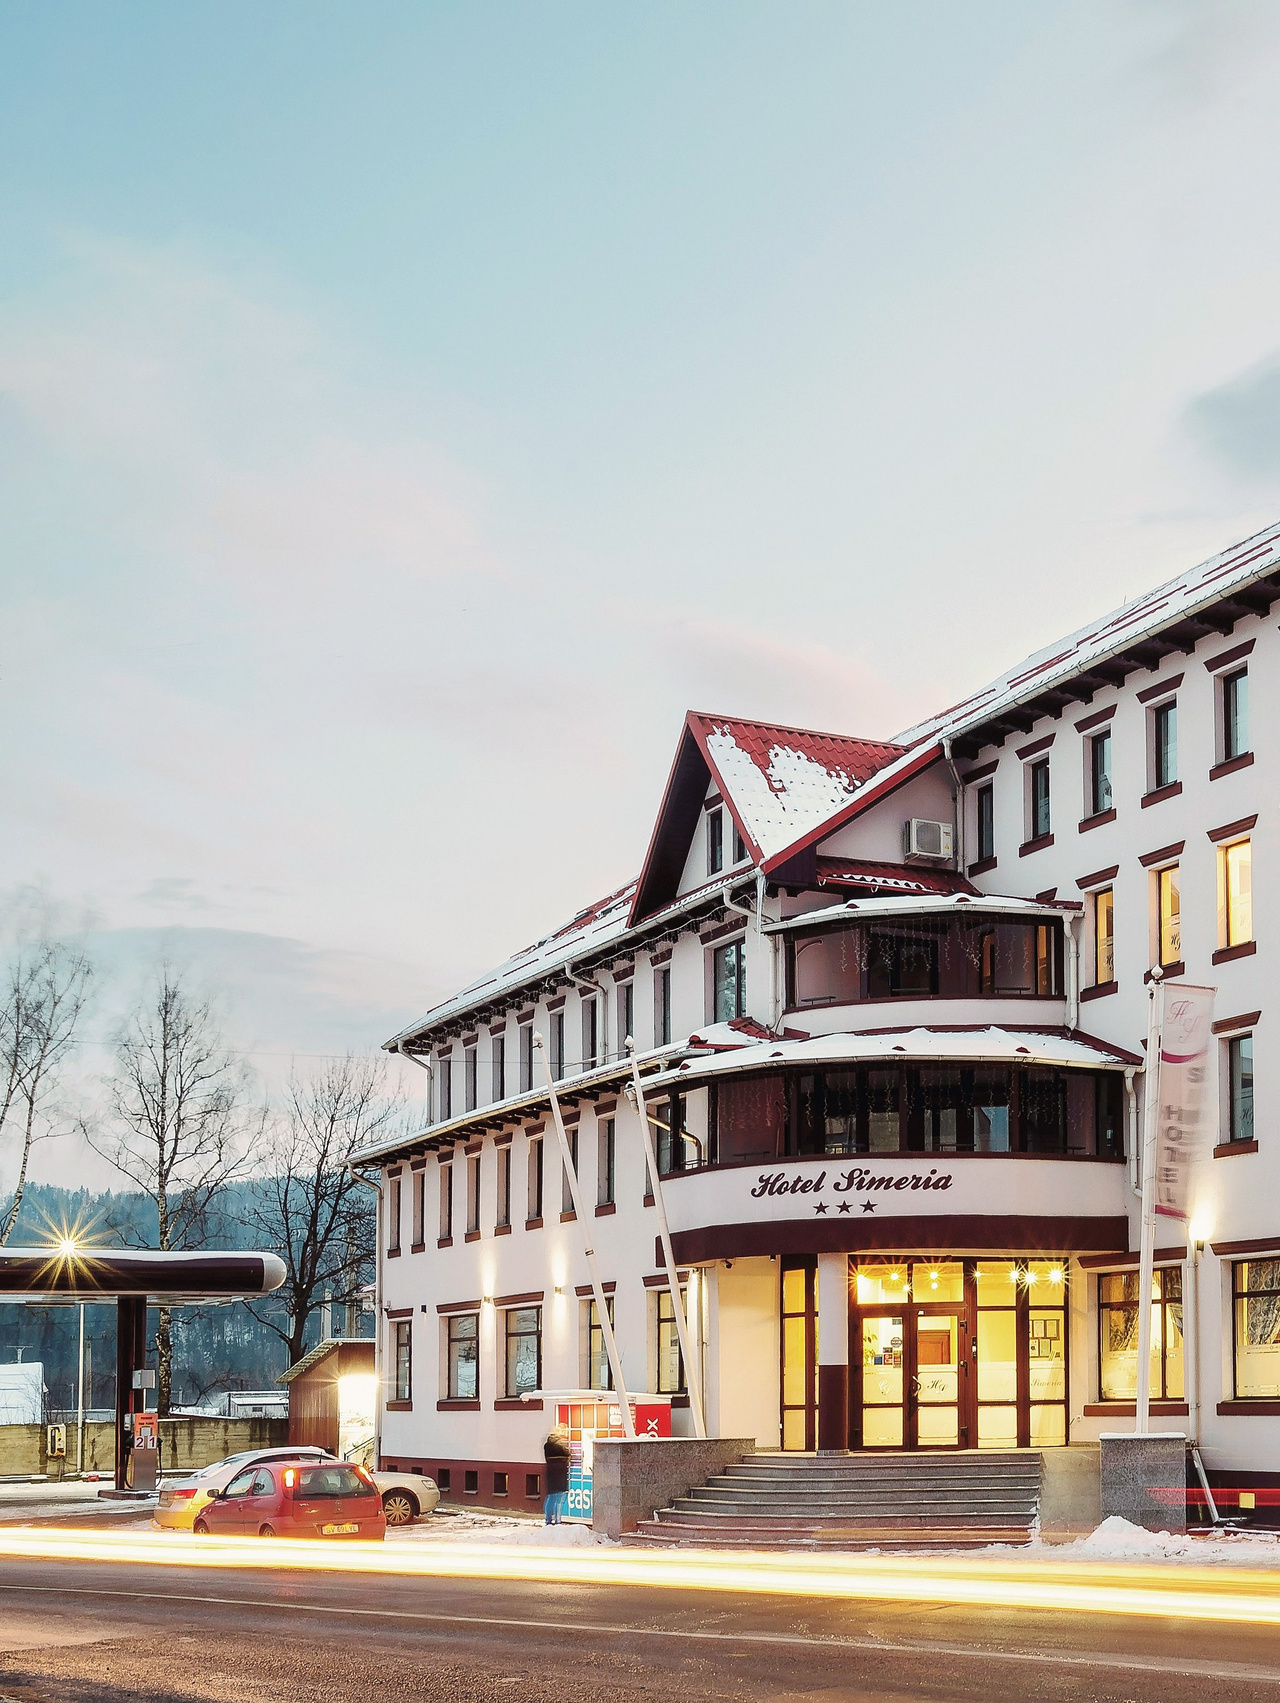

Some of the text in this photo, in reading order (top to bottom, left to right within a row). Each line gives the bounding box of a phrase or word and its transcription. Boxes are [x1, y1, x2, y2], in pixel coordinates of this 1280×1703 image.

[751, 1168, 953, 1198] Hotel Simeria
[136, 1437, 155, 1447] 2 1
[567, 1488, 592, 1510] eas
